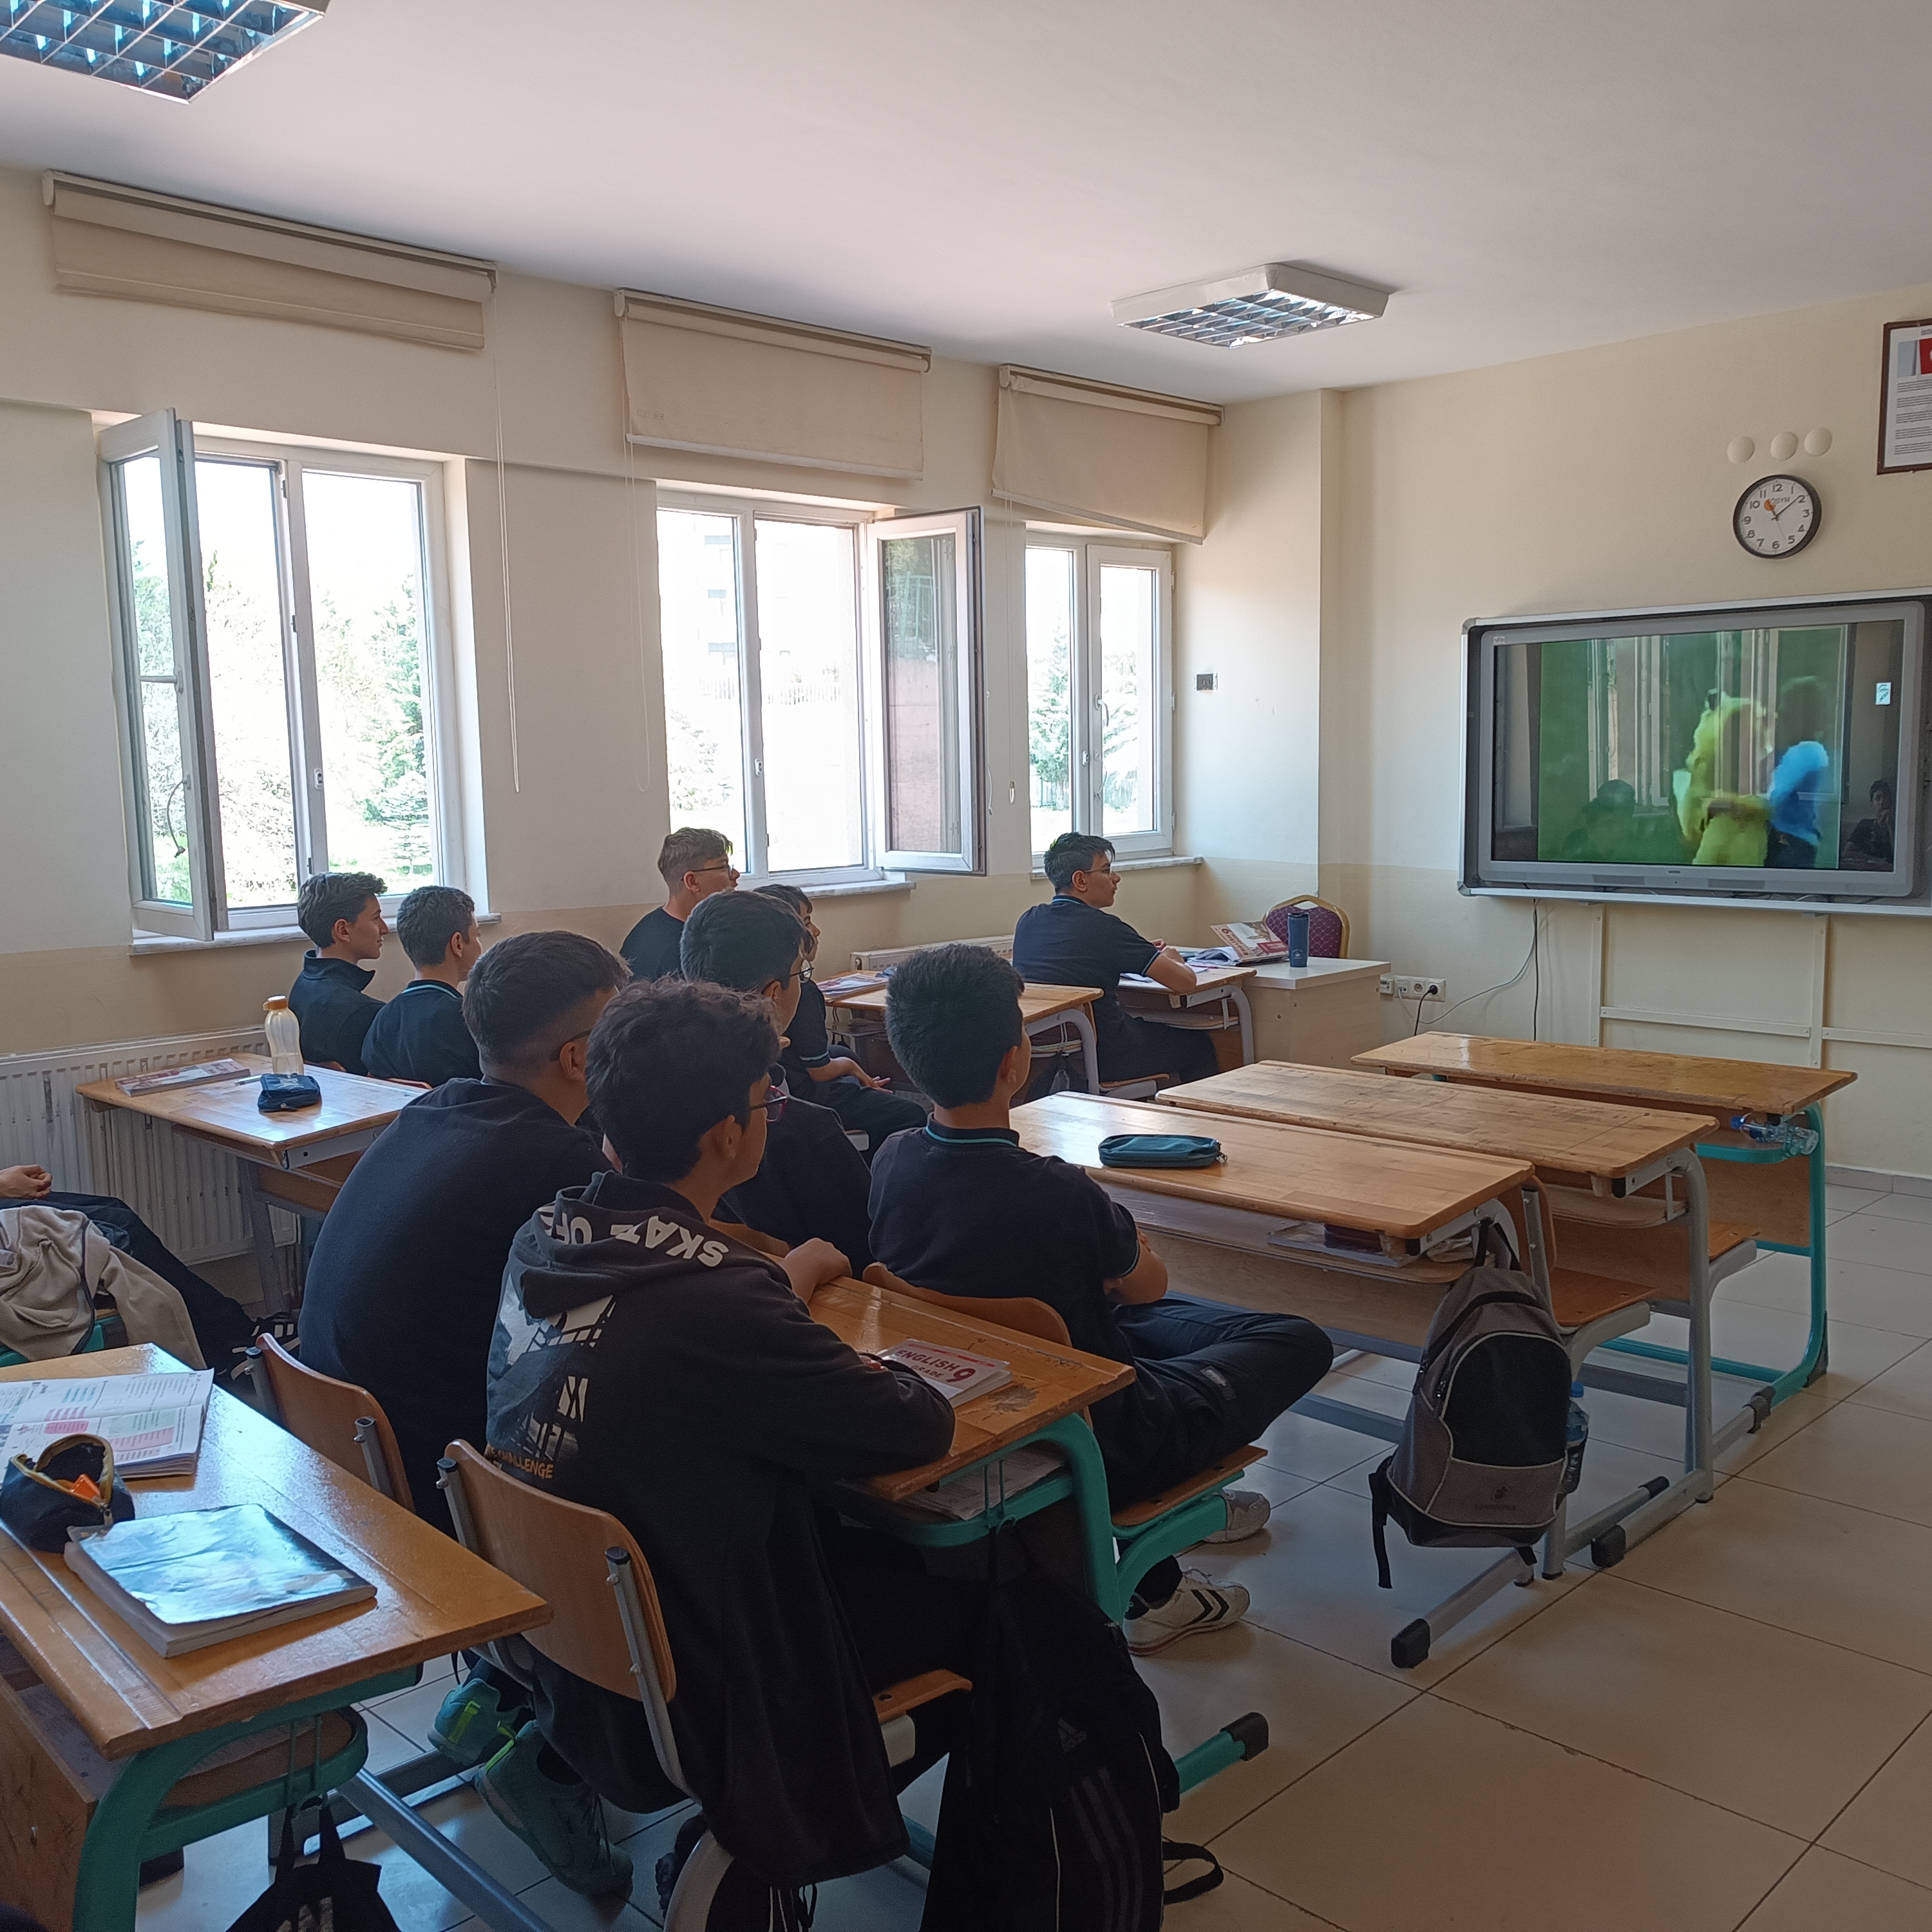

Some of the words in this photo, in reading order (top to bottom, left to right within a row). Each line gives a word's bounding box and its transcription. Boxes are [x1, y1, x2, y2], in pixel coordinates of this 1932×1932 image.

[1772, 483, 1783, 493] 12
[1790, 486, 1794, 495] 1
[1759, 489, 1766, 498] 11
[1797, 495, 1806, 503] 2
[1749, 500, 1761, 509] 10
[1803, 509, 1810, 518] 3
[1743, 516, 1752, 525] 9
[1797, 524, 1805, 533] 4
[1747, 529, 1756, 538] 8
[1756, 538, 1765, 548] 7
[1788, 535, 1795, 544] 5
[1772, 540, 1780, 549] 6
[1225, 933, 1249, 956] ENGLISH
[895, 1349, 961, 1372] ENGLISH
[946, 1368, 976, 1383] 9
[911, 1365, 944, 1378] GRADE
